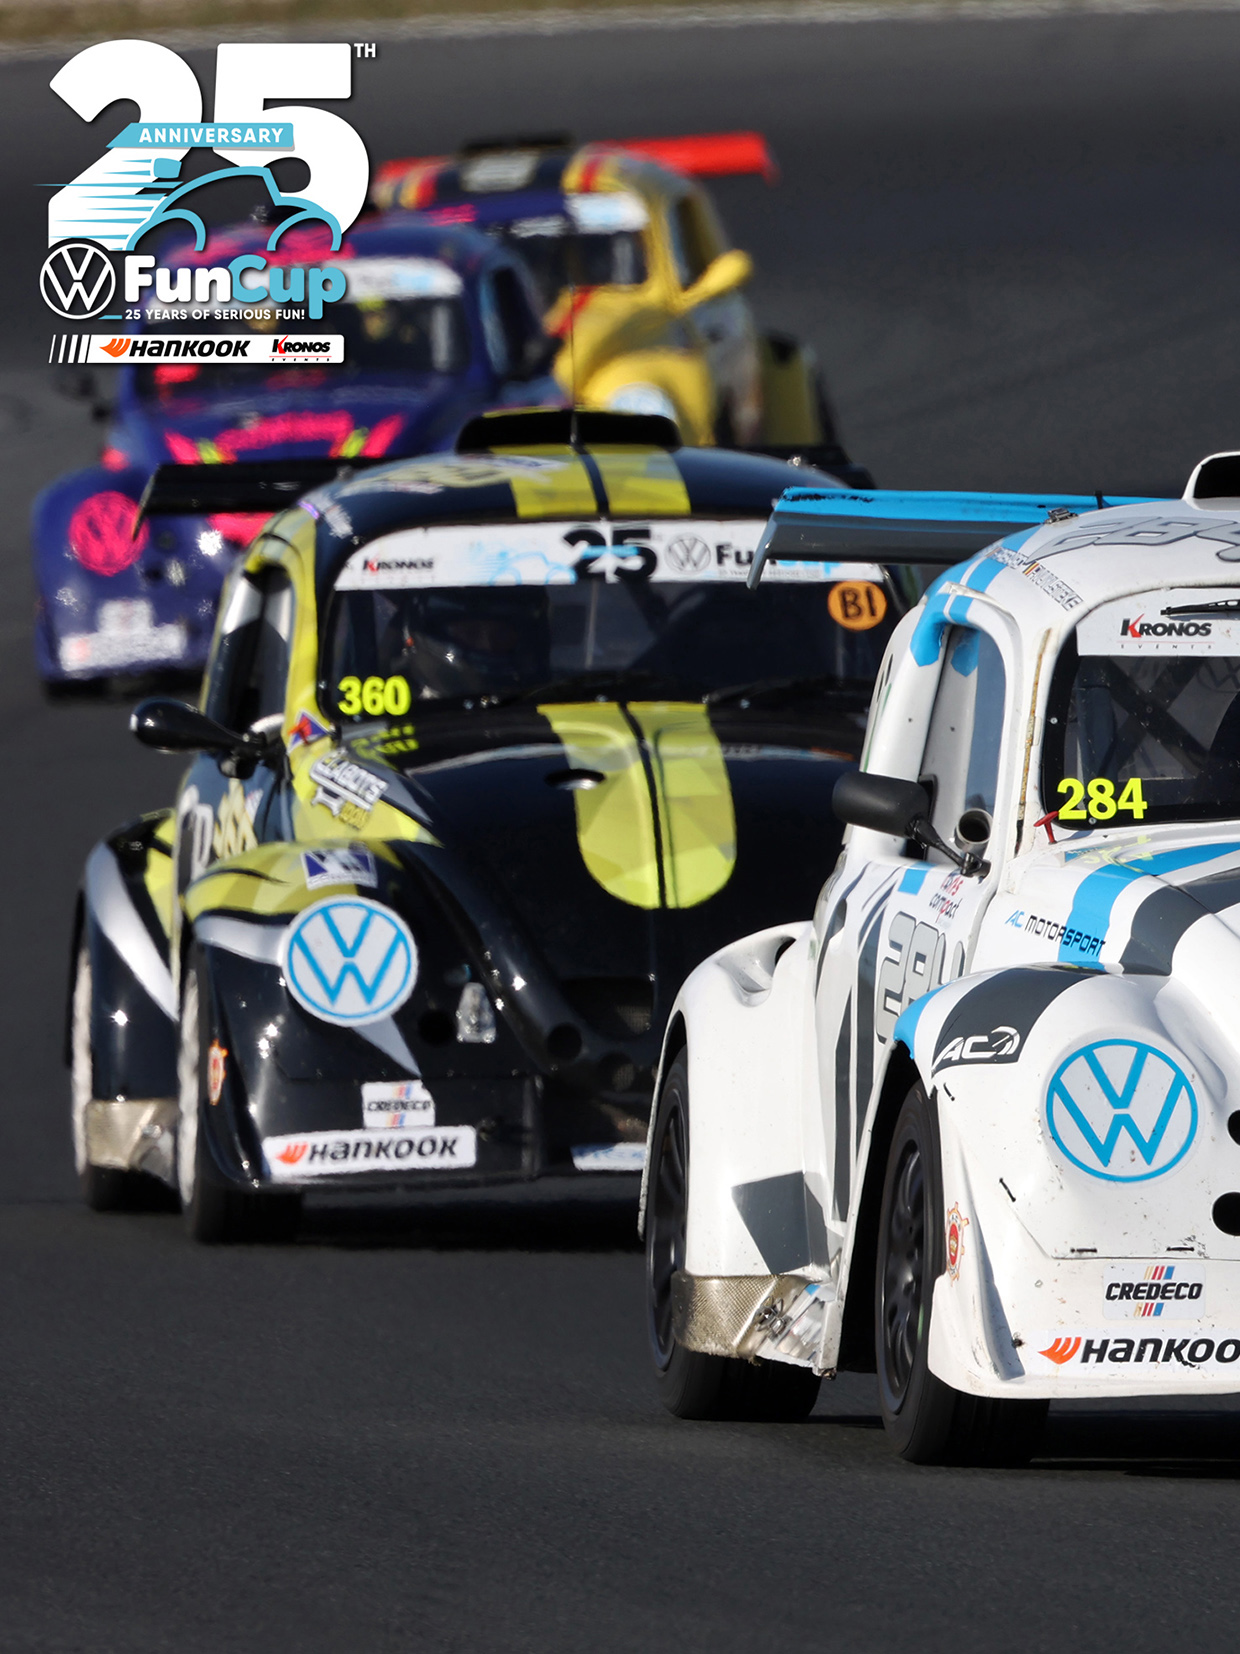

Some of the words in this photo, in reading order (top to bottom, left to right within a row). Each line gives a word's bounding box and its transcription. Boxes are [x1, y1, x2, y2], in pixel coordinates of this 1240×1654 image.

[562, 527, 658, 583] 25
[1120, 613, 1212, 638] KRONOS
[338, 675, 411, 716] 360
[1057, 777, 1148, 820] 284
[1005, 910, 1025, 928] AC
[1024, 915, 1106, 957] MOTORSPORT
[367, 1100, 431, 1112] CREDECO
[1104, 1282, 1204, 1301] CREDECO
